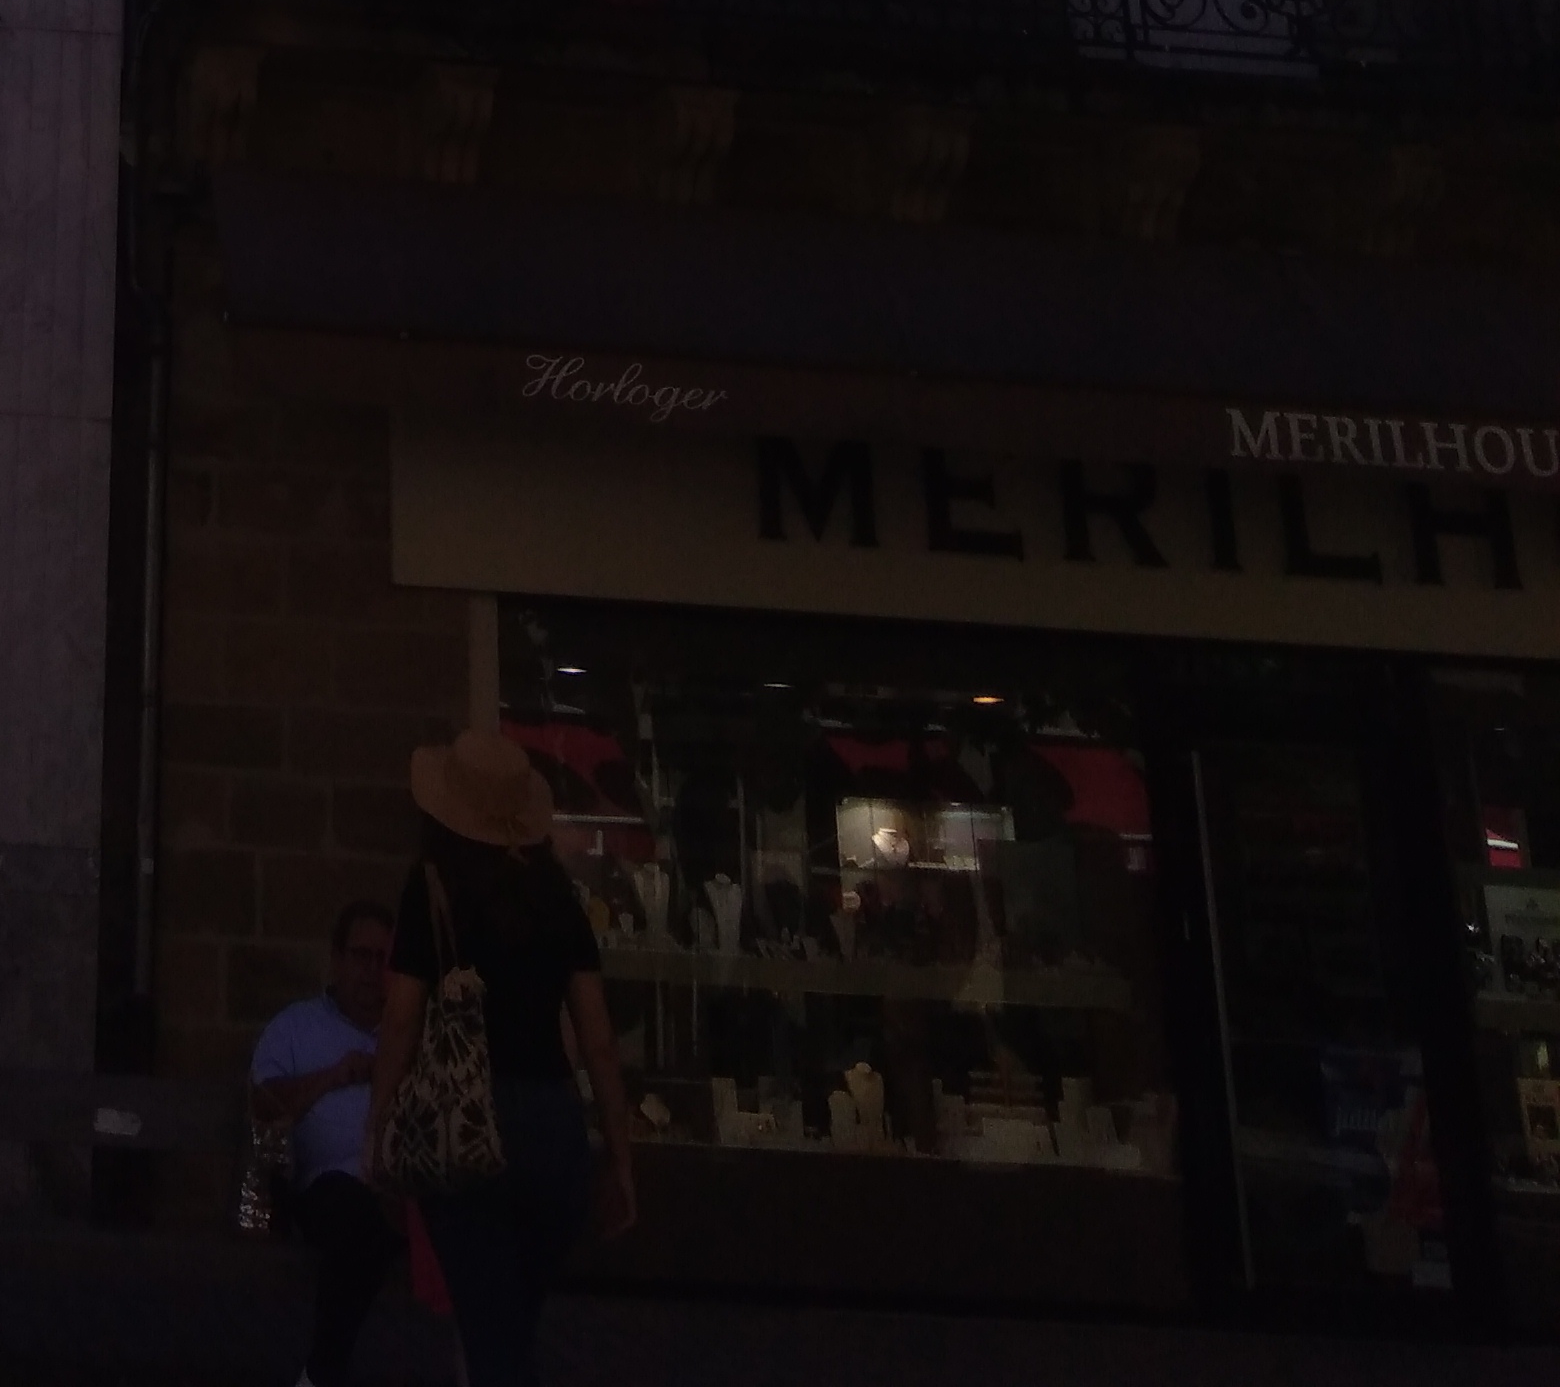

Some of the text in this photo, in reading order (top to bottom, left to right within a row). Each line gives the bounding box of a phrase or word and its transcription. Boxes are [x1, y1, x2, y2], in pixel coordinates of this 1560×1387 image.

[521, 353, 730, 423] Horloger
[1224, 407, 1560, 477] MERILHOU
[753, 435, 1560, 591] MERILH
